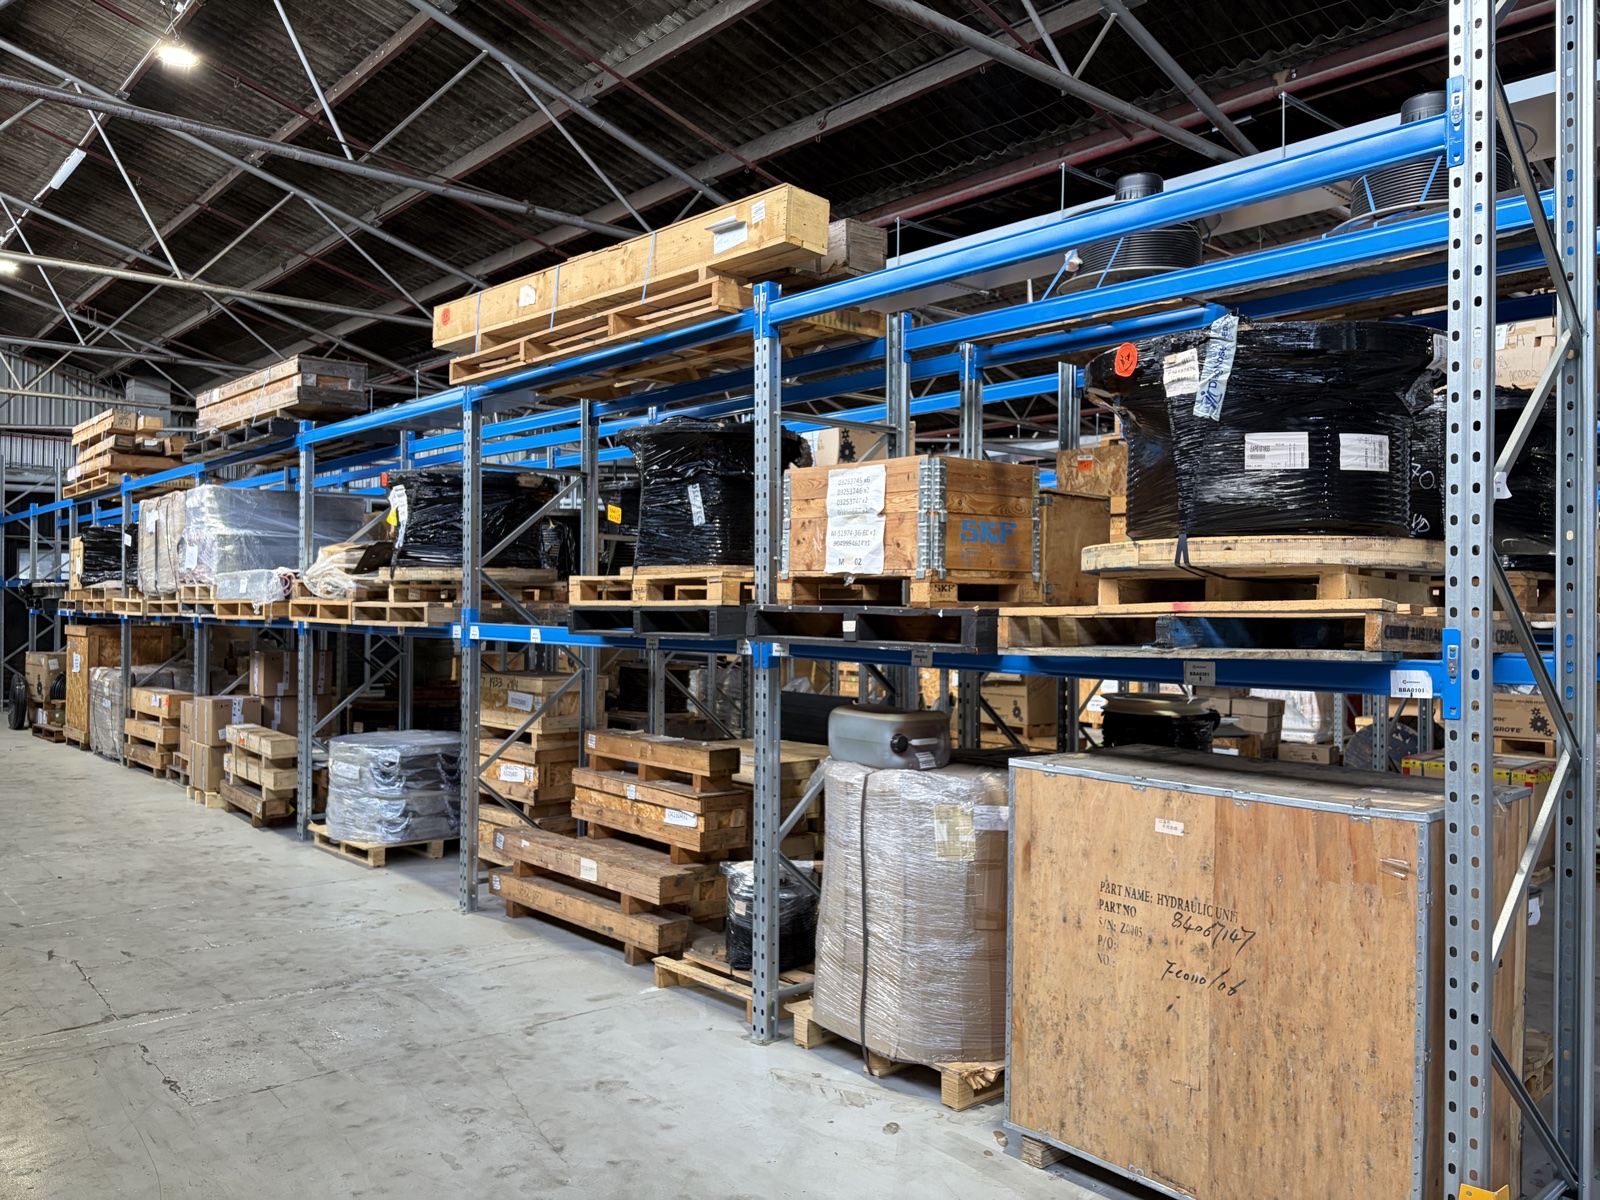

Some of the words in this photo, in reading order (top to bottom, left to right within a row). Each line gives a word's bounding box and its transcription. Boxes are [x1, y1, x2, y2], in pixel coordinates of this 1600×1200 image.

[960, 518, 1018, 545] SKF
[1100, 881, 1124, 897] PART
[1124, 886, 1153, 904] NAME:
[1157, 893, 1213, 918] HYDRAULIC
